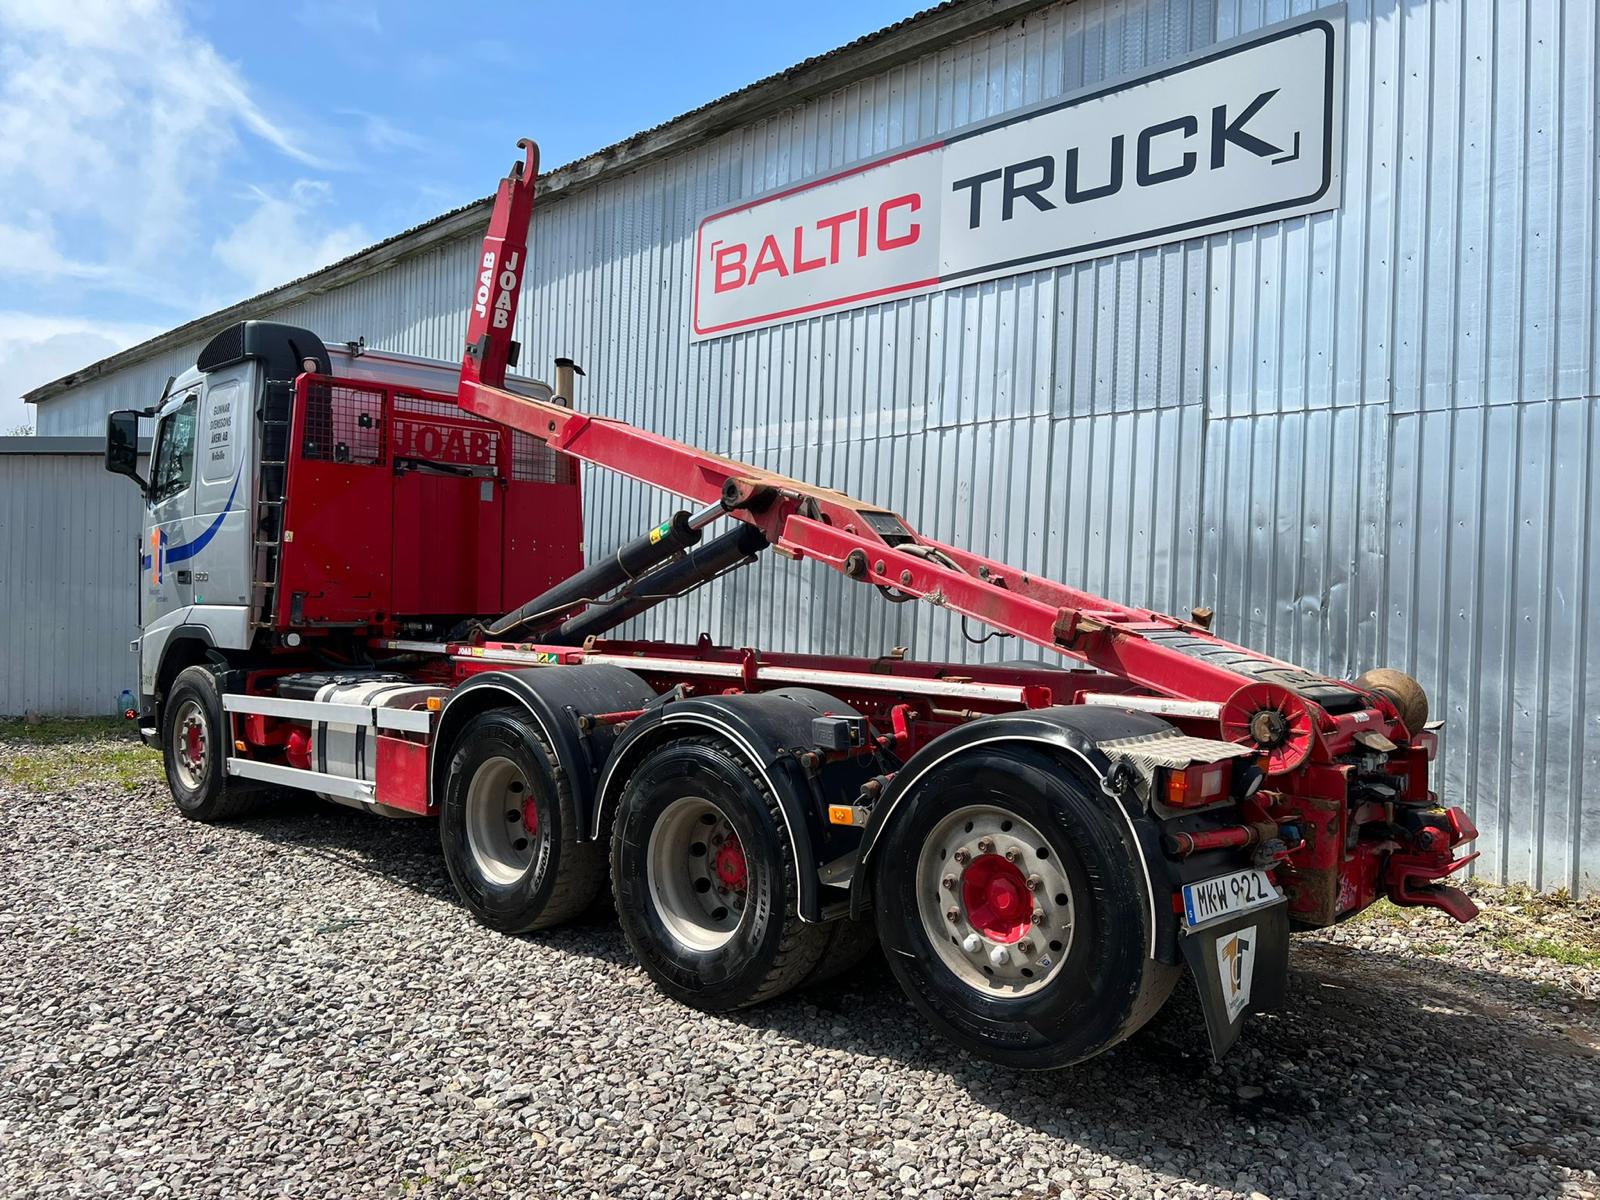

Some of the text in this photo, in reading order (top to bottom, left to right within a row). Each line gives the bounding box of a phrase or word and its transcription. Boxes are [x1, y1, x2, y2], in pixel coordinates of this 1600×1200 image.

[714, 88, 1285, 294] BALTIC TRUCK
[475, 251, 495, 318] JOAB
[492, 251, 519, 329] JOAB
[393, 423, 491, 464] JOAB
[534, 845, 550, 889] WORKS
[1196, 872, 1269, 917] MKW 922
